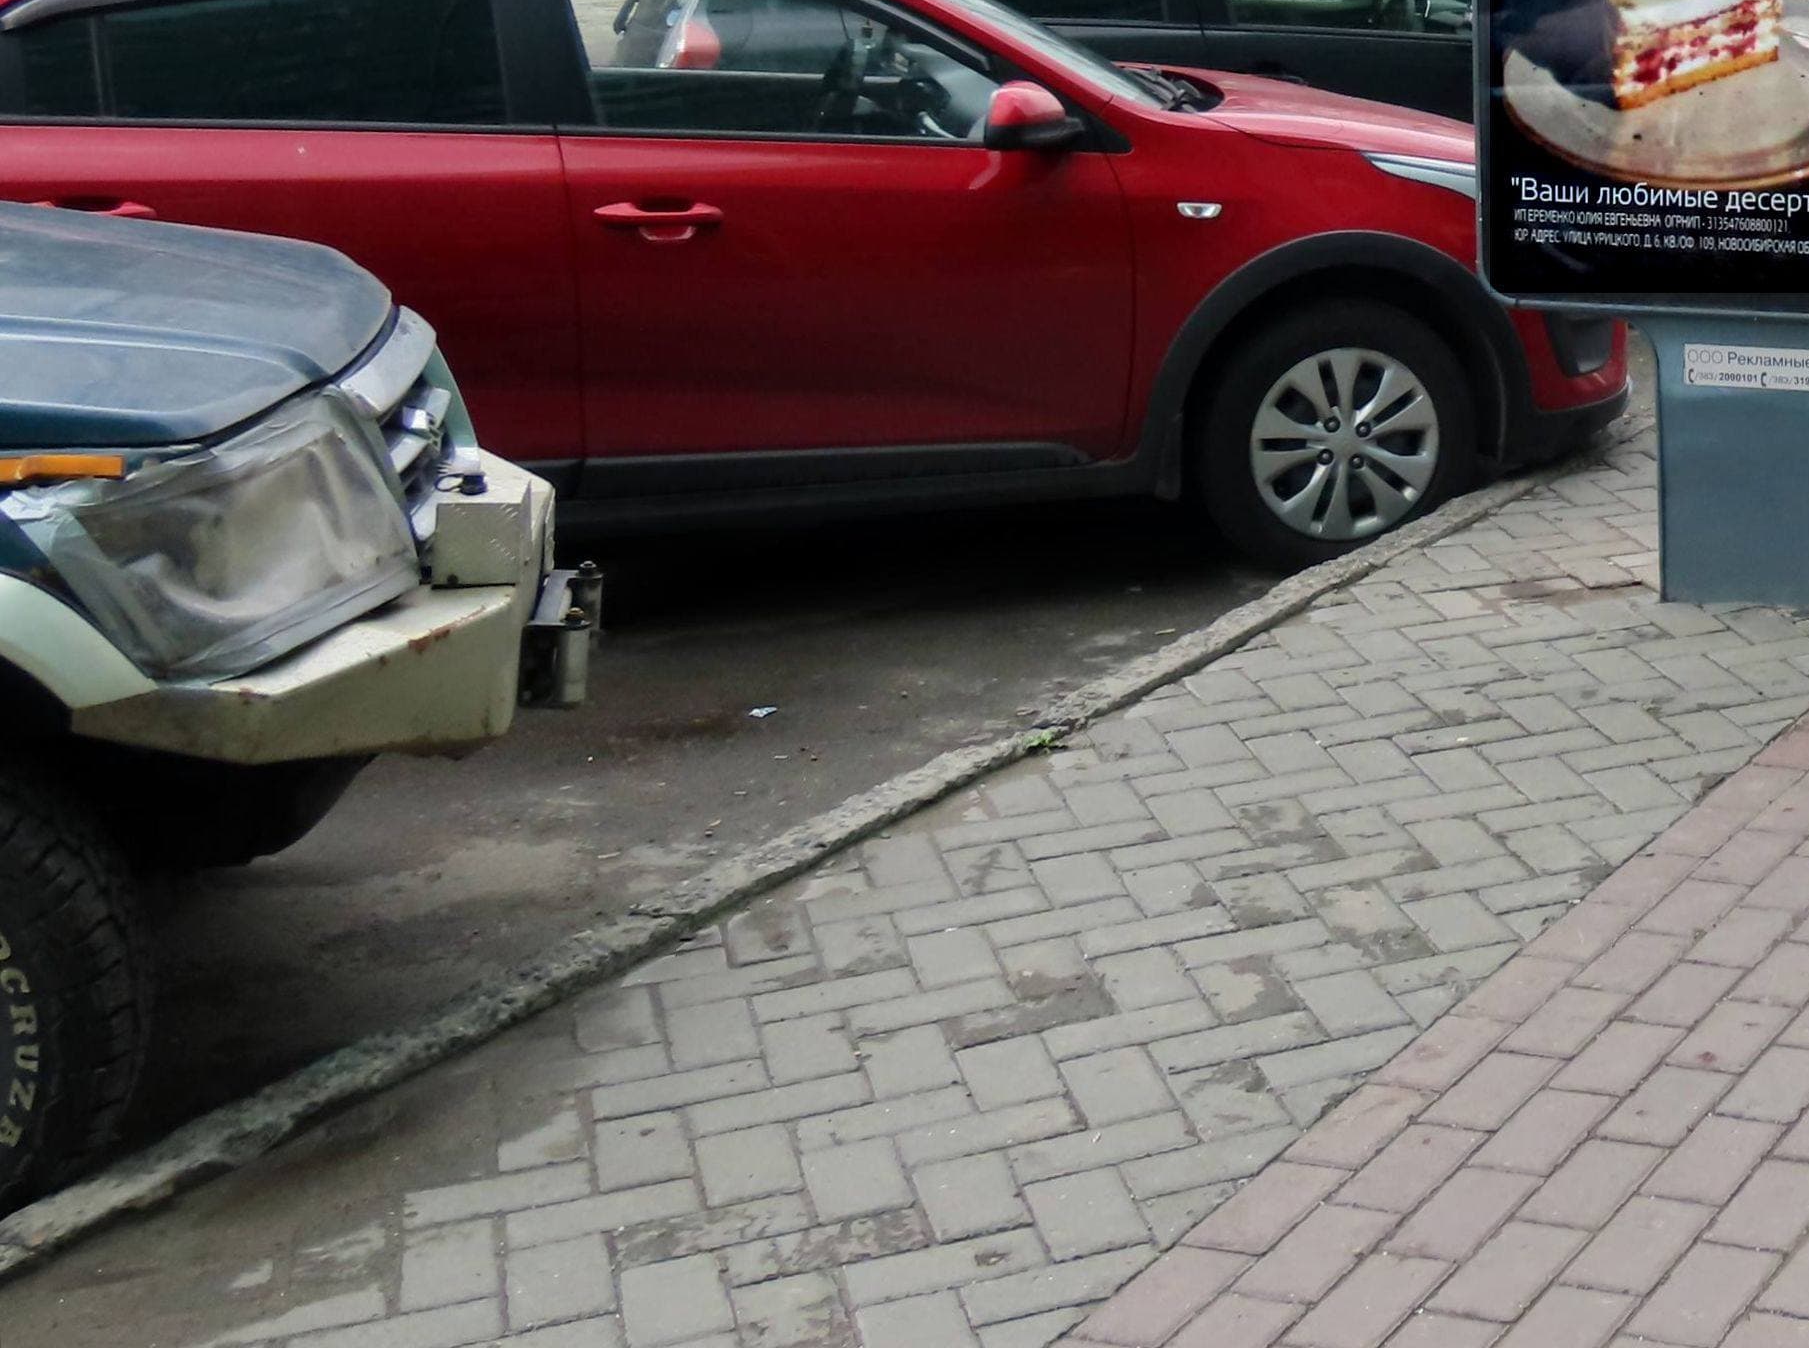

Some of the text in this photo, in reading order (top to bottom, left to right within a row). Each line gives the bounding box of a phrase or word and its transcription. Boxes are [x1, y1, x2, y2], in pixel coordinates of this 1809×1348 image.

[1511, 177, 1589, 203] "Ваши
[1596, 182, 1719, 208] любимые
[1514, 208, 1527, 221] ИП
[1576, 210, 1603, 225] ЮЛИЯ
[1604, 212, 1662, 227] ЕВГЕНЬЕВНА
[1664, 214, 1701, 229] ОГРНИП
[1687, 348, 1723, 364] ООО
